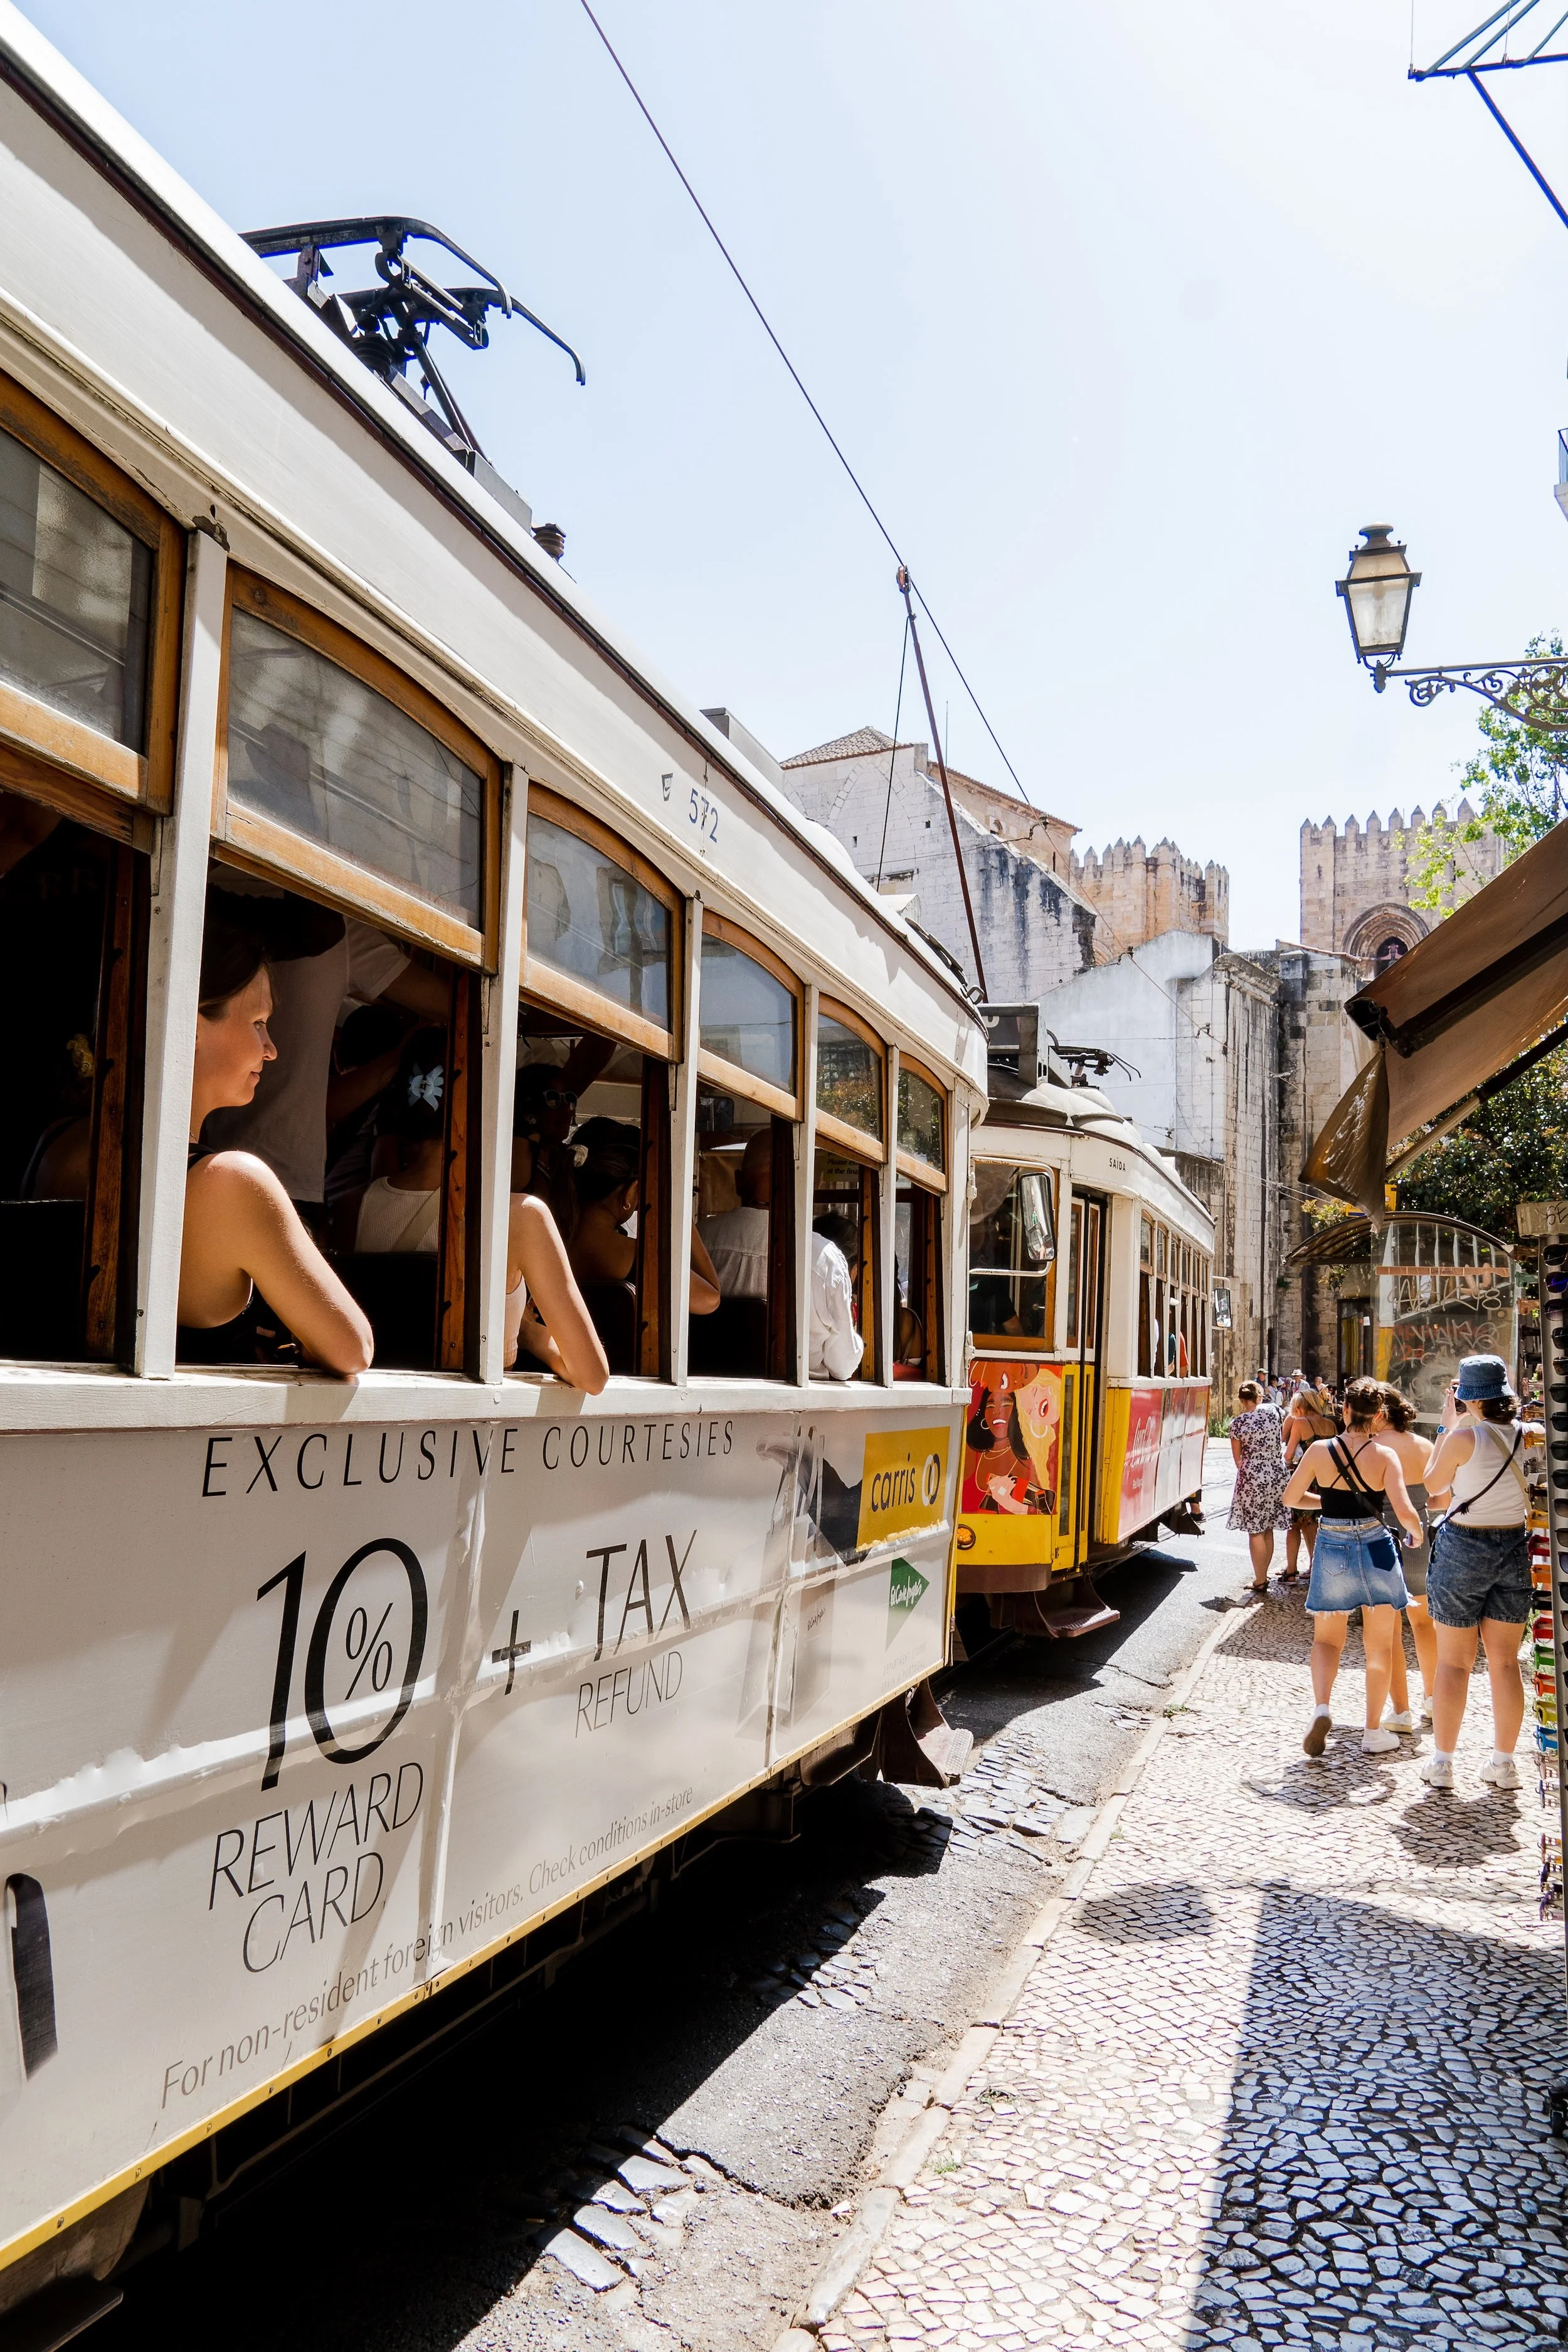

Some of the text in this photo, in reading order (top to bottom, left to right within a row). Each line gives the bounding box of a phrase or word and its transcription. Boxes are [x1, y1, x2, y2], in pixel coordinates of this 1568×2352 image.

[689, 788, 718, 844] 572
[1109, 1157, 1126, 1172] SAÍDA
[202, 1421, 733, 1496] EXCLUSIVE COURTESIES
[871, 1453, 916, 1512] carris
[586, 1530, 697, 1661] TAX
[575, 1651, 683, 1737] REFUND
[209, 1762, 423, 1910] REWARD
[161, 1784, 693, 2109] For non-resident foreign visitors. Check conditions in-store
[243, 1851, 384, 1972] CARD
